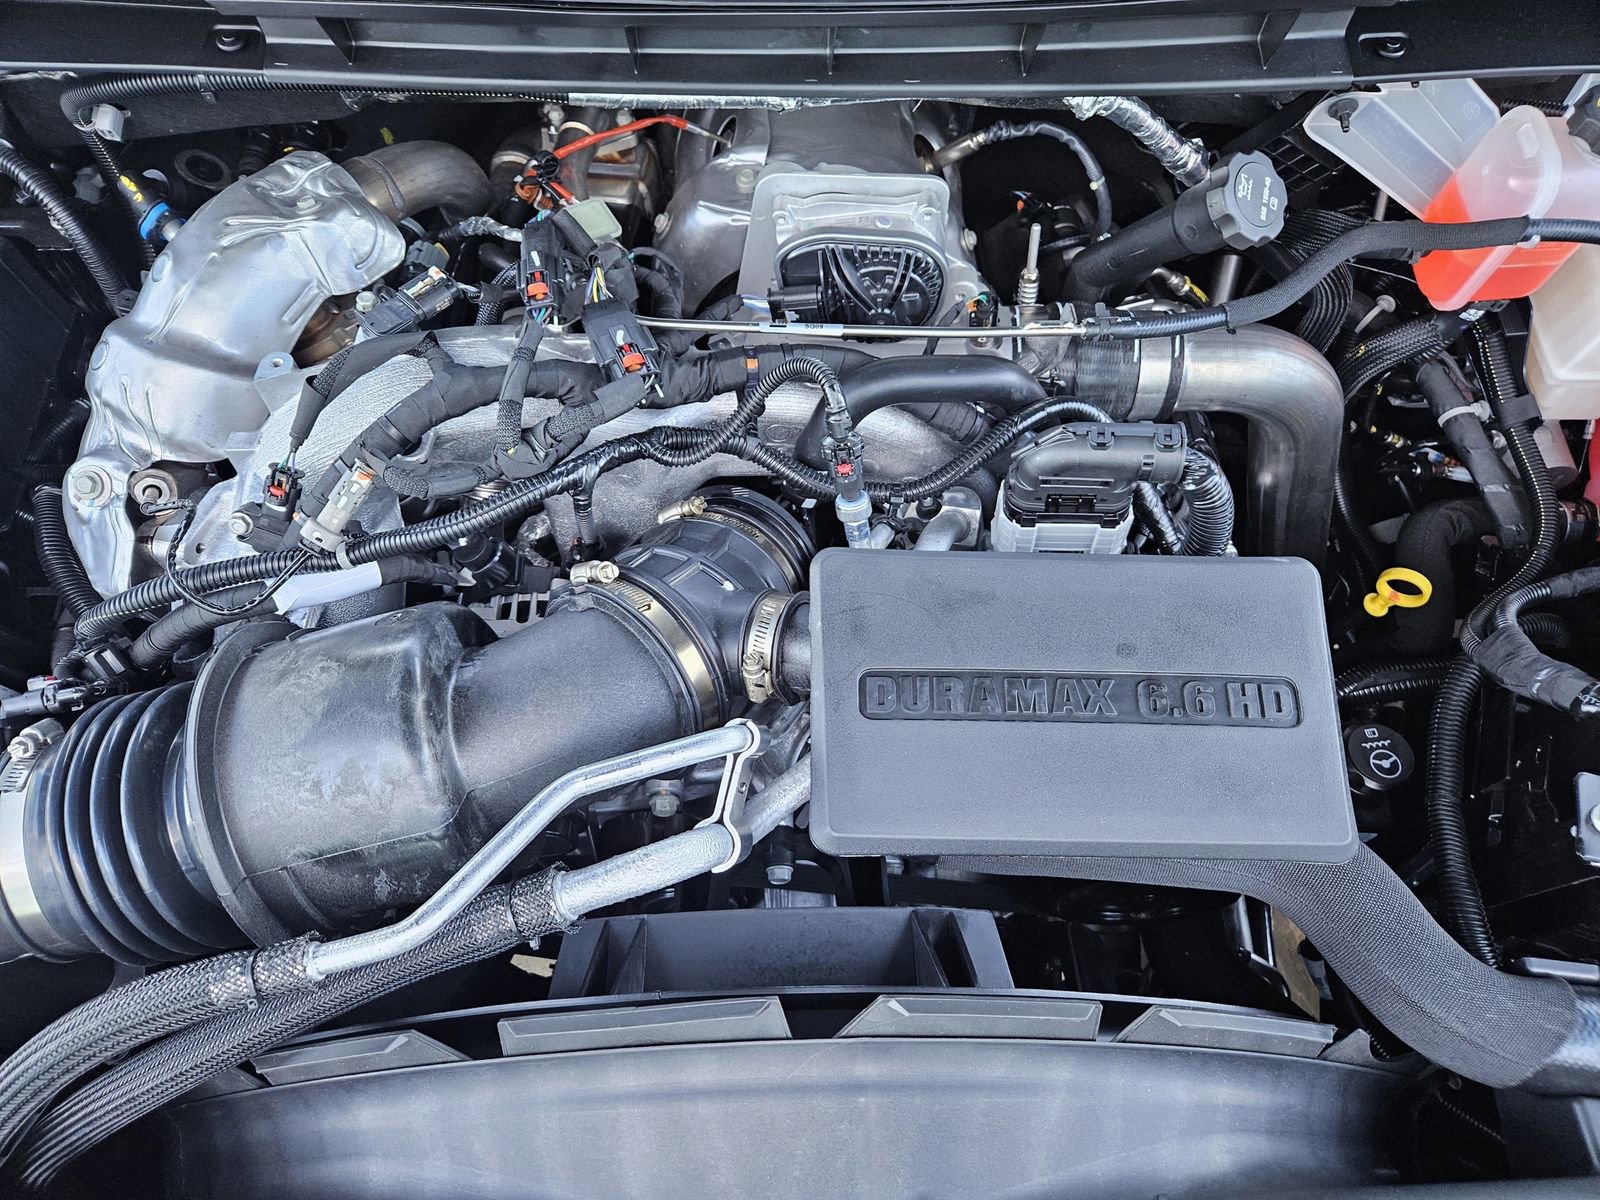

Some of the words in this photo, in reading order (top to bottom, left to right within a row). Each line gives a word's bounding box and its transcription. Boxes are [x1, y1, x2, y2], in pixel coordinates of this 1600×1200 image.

[864, 675, 1118, 716] DURAMAX
[1136, 679, 1216, 719] 6.6
[1225, 682, 1294, 720] HD
